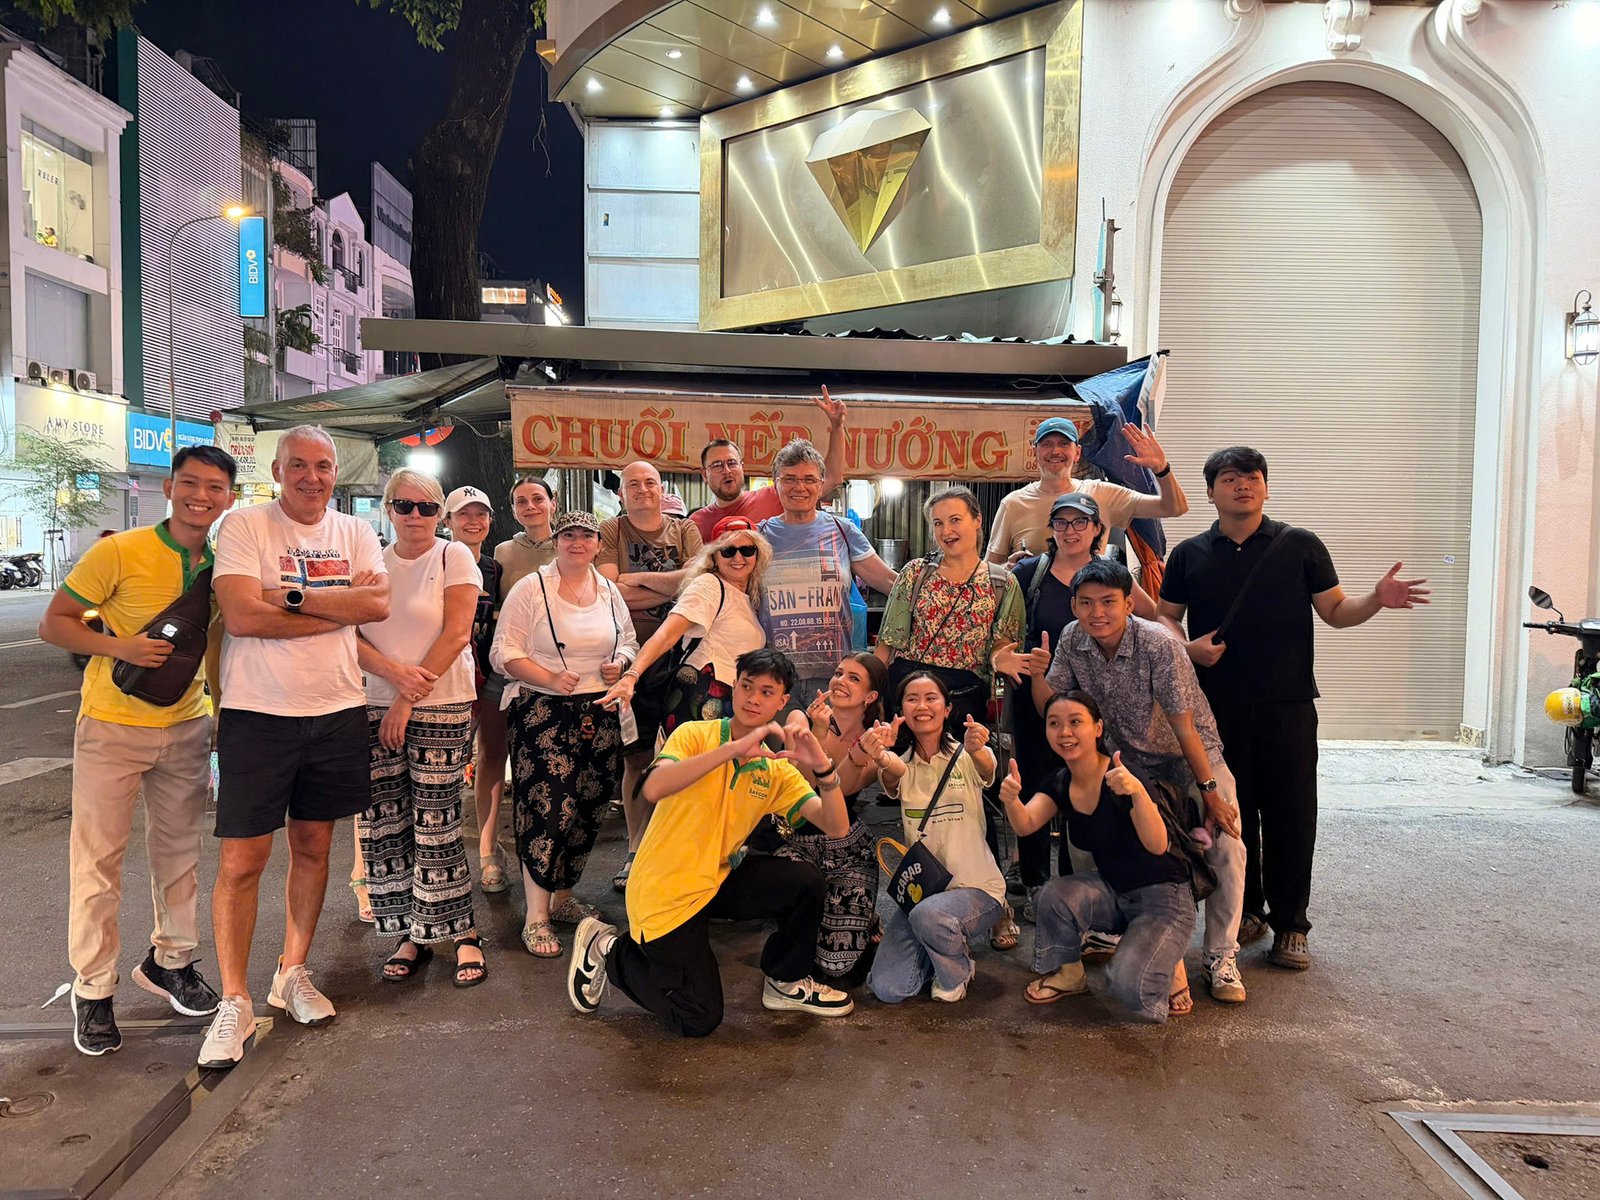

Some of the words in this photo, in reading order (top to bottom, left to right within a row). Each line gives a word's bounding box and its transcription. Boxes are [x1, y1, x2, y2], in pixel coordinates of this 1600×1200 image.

[248, 257, 258, 284] BIDV
[46, 417, 69, 430] AMY
[72, 421, 104, 435] STORE
[134, 427, 165, 452] BIDV
[522, 407, 689, 461] CHUỐI
[896, 862, 923, 904] SCARAB
